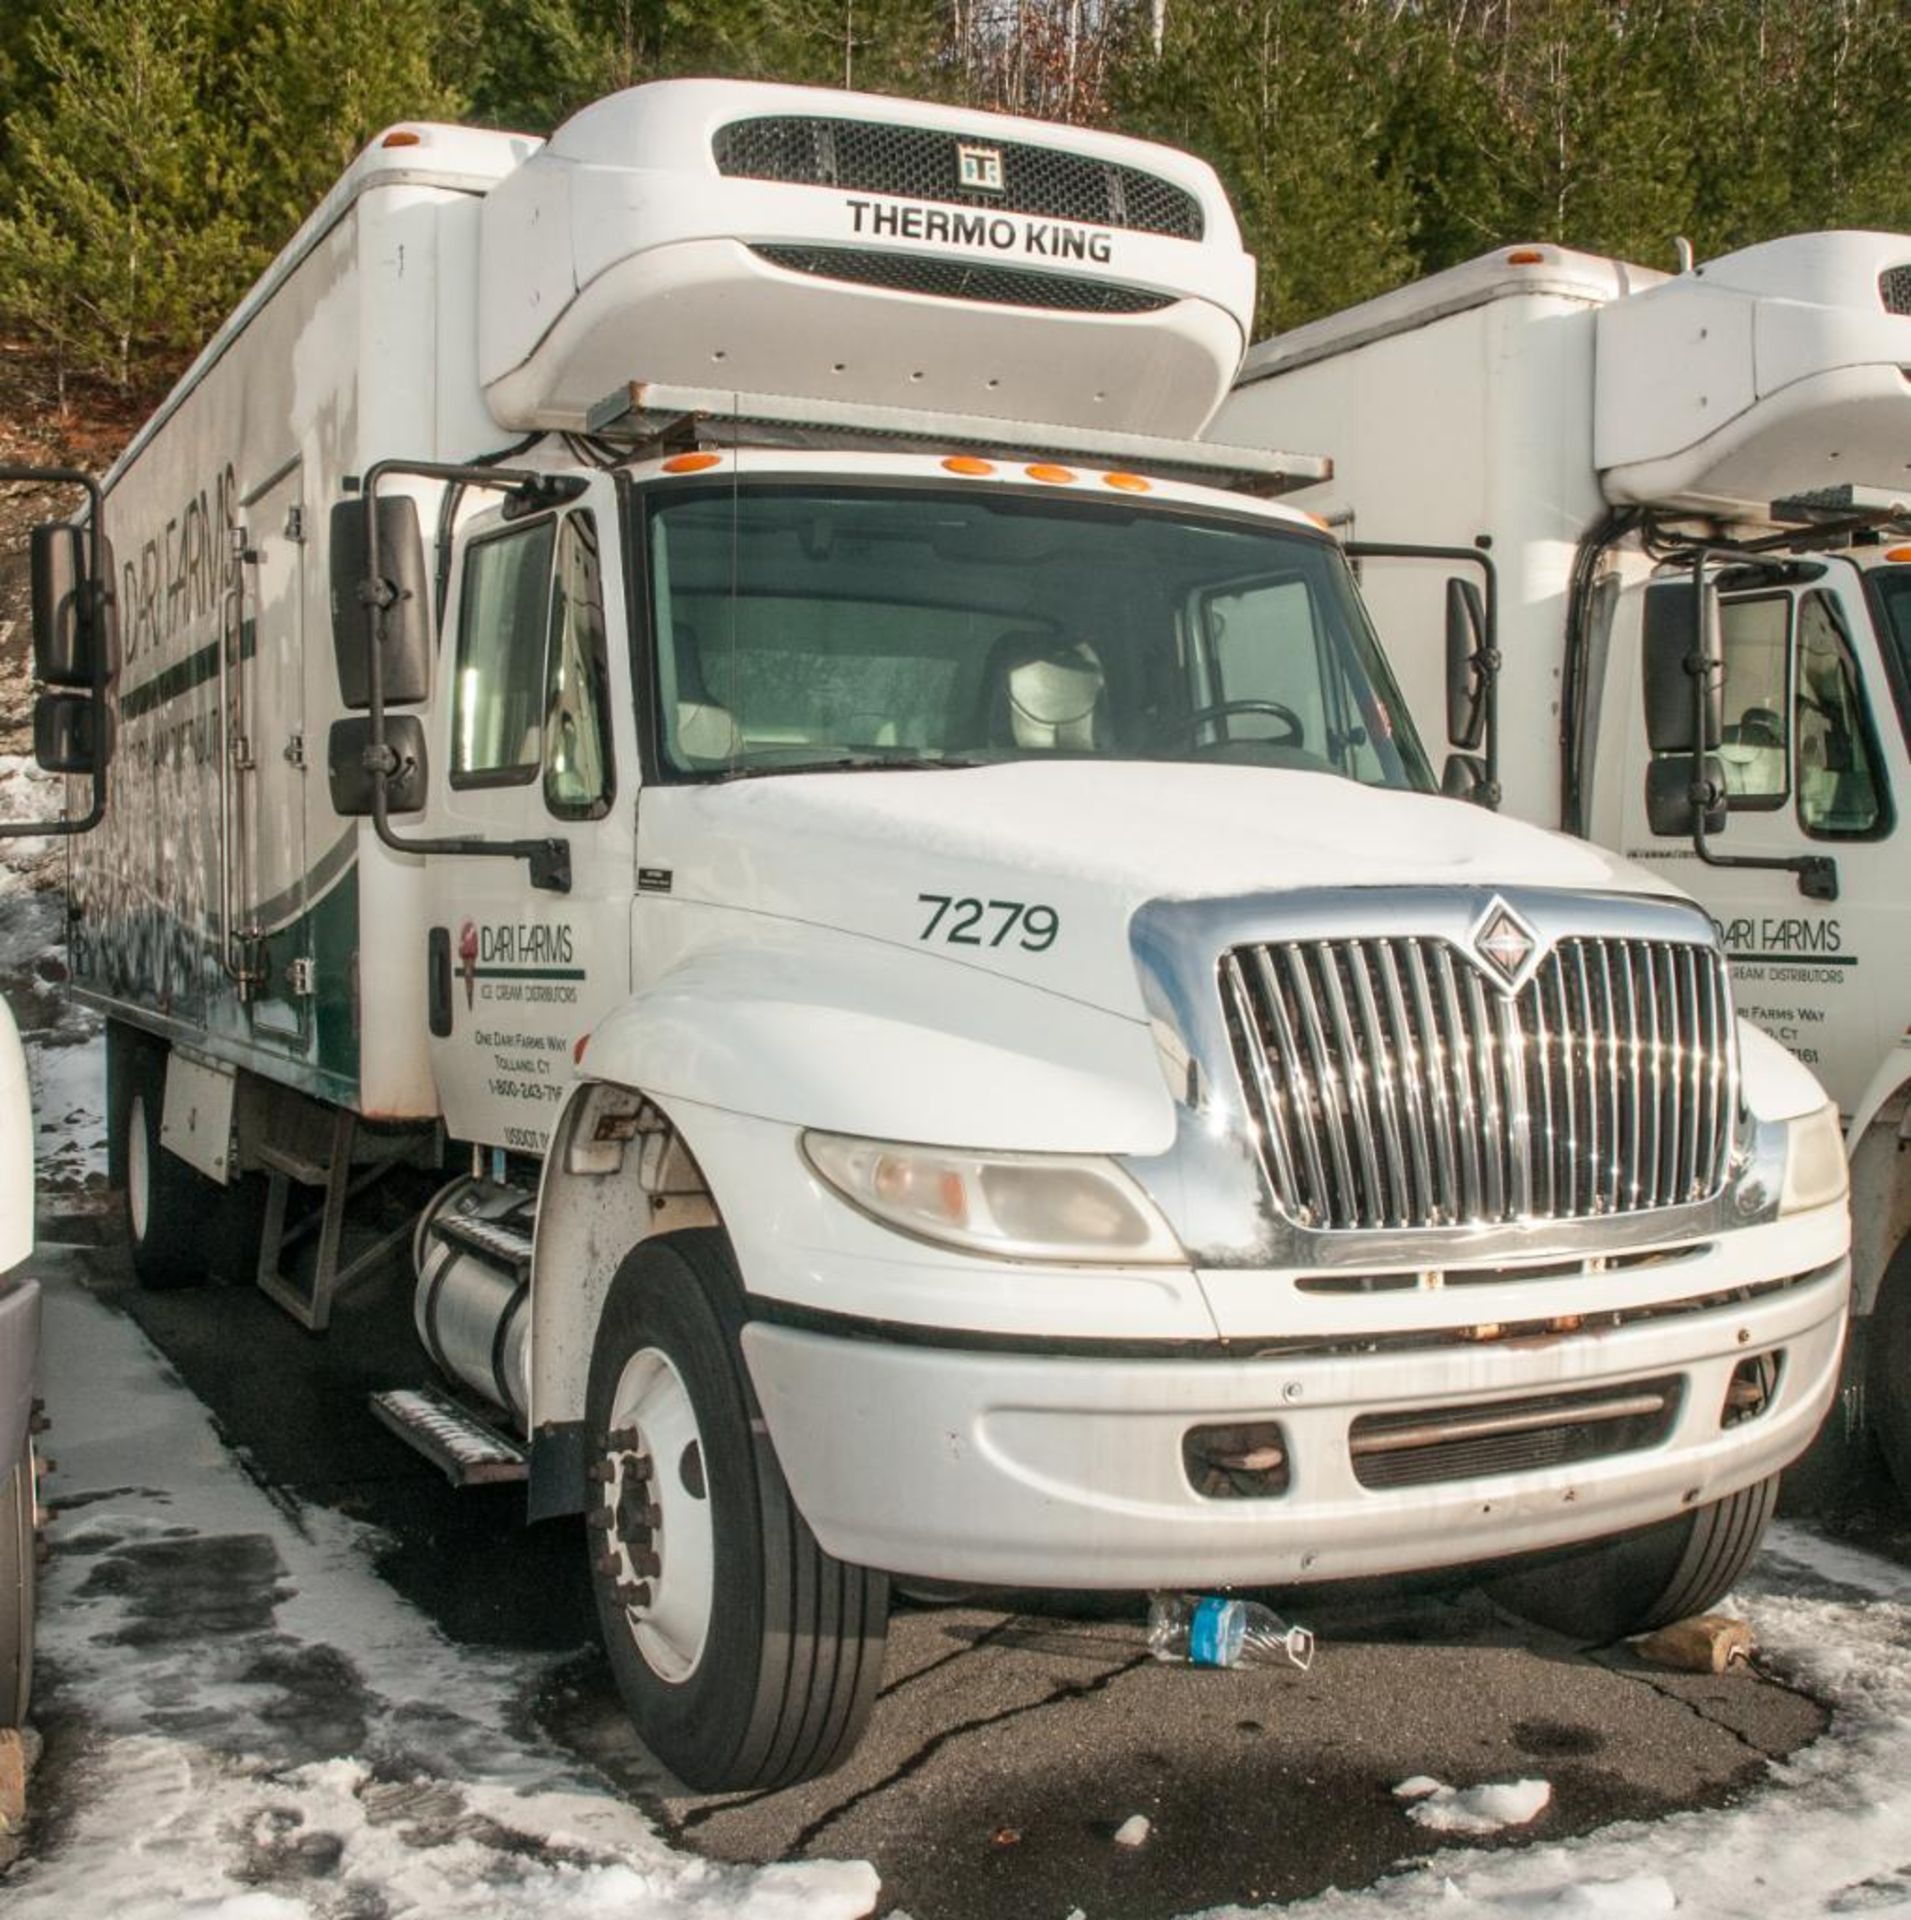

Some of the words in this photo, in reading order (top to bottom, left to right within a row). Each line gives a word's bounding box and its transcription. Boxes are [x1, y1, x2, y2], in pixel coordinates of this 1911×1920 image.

[847, 200, 1016, 250] THERMO
[1025, 222, 1112, 263] KING
[166, 462, 236, 640] FARMS
[918, 893, 1059, 952] 7279
[1761, 918, 1841, 952] FARMS
[481, 925, 514, 962] DARI
[518, 924, 573, 963] FARMS
[480, 984, 494, 1000] ICE
[1733, 966, 1764, 981] REAM
[1769, 967, 1845, 984] DISTRIBUTORS
[1751, 1005, 1795, 1021] FARMS
[488, 1078, 563, 1102] 1-800-243-716
